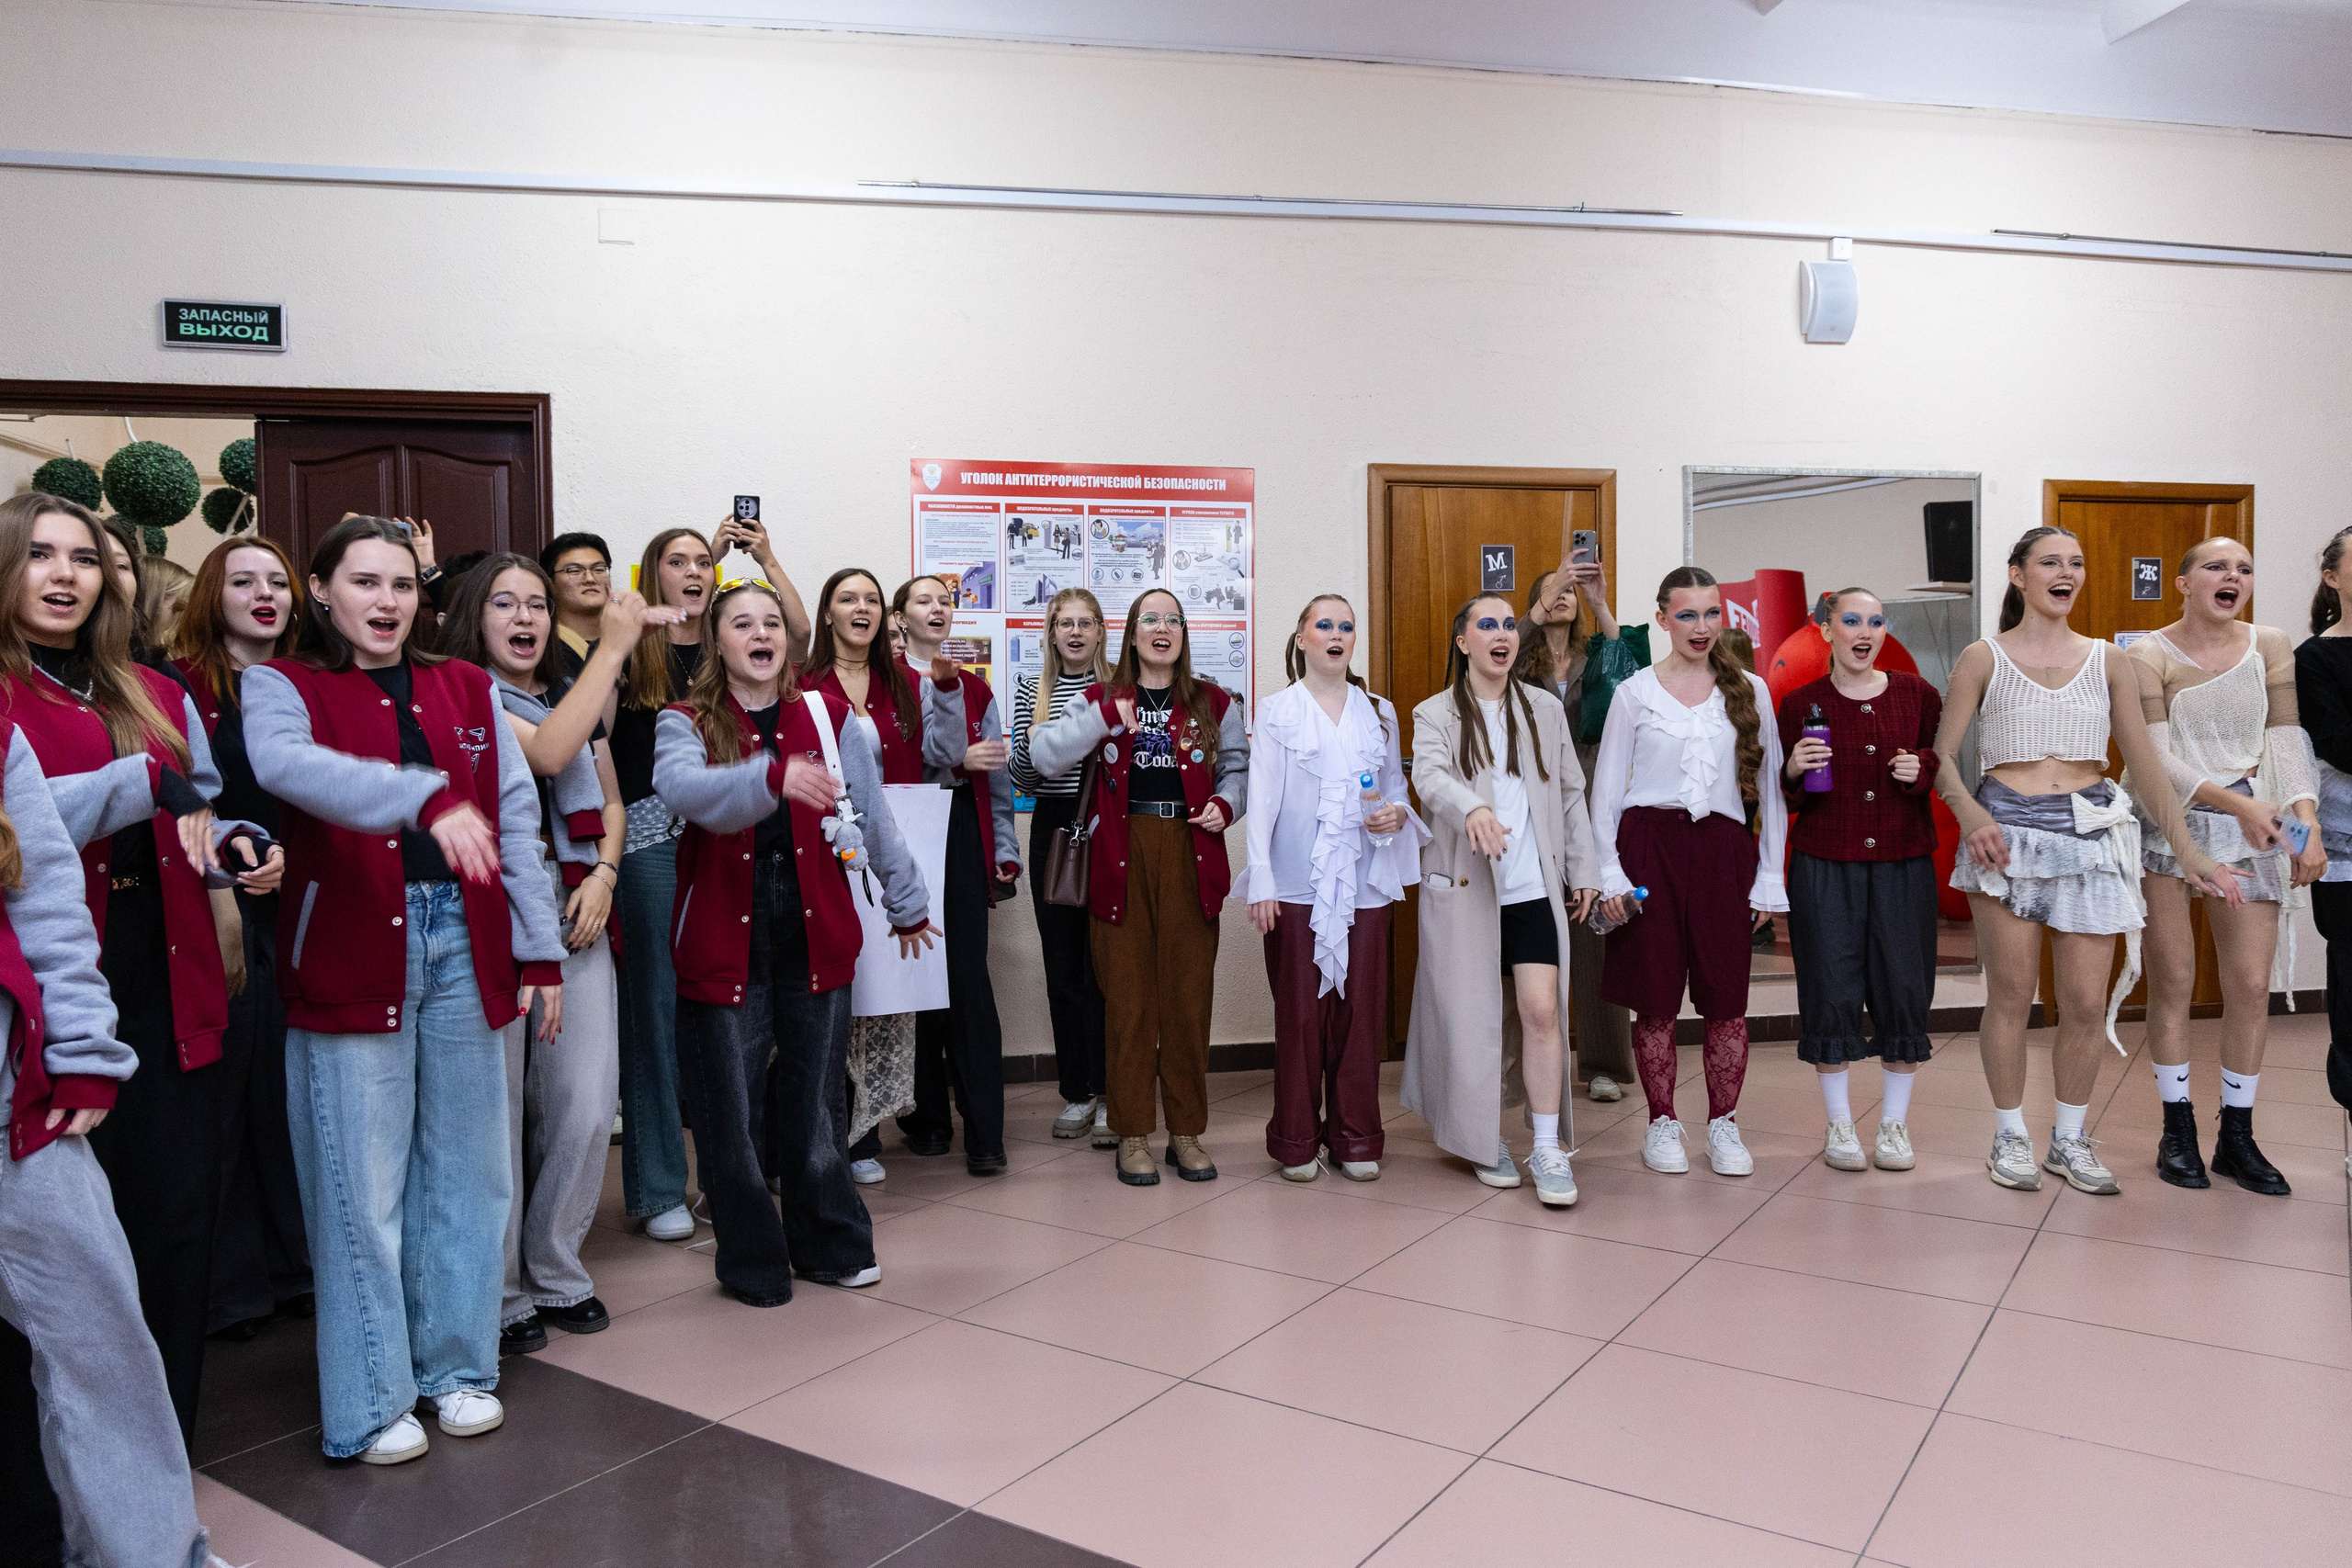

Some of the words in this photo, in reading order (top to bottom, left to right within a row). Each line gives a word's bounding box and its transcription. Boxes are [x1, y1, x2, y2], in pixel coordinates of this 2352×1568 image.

[179, 309, 269, 324] ЗАПАСНЫЙ
[179, 323, 269, 342] ВЫХОД
[960, 472, 1003, 485] УГОЛОК
[1004, 473, 1142, 489] АНТИТЕРРОРИСТИЧЕСКОЙ
[1143, 477, 1227, 491] БЕЗОПАСНОСТИ
[2139, 564, 2157, 581] Ж
